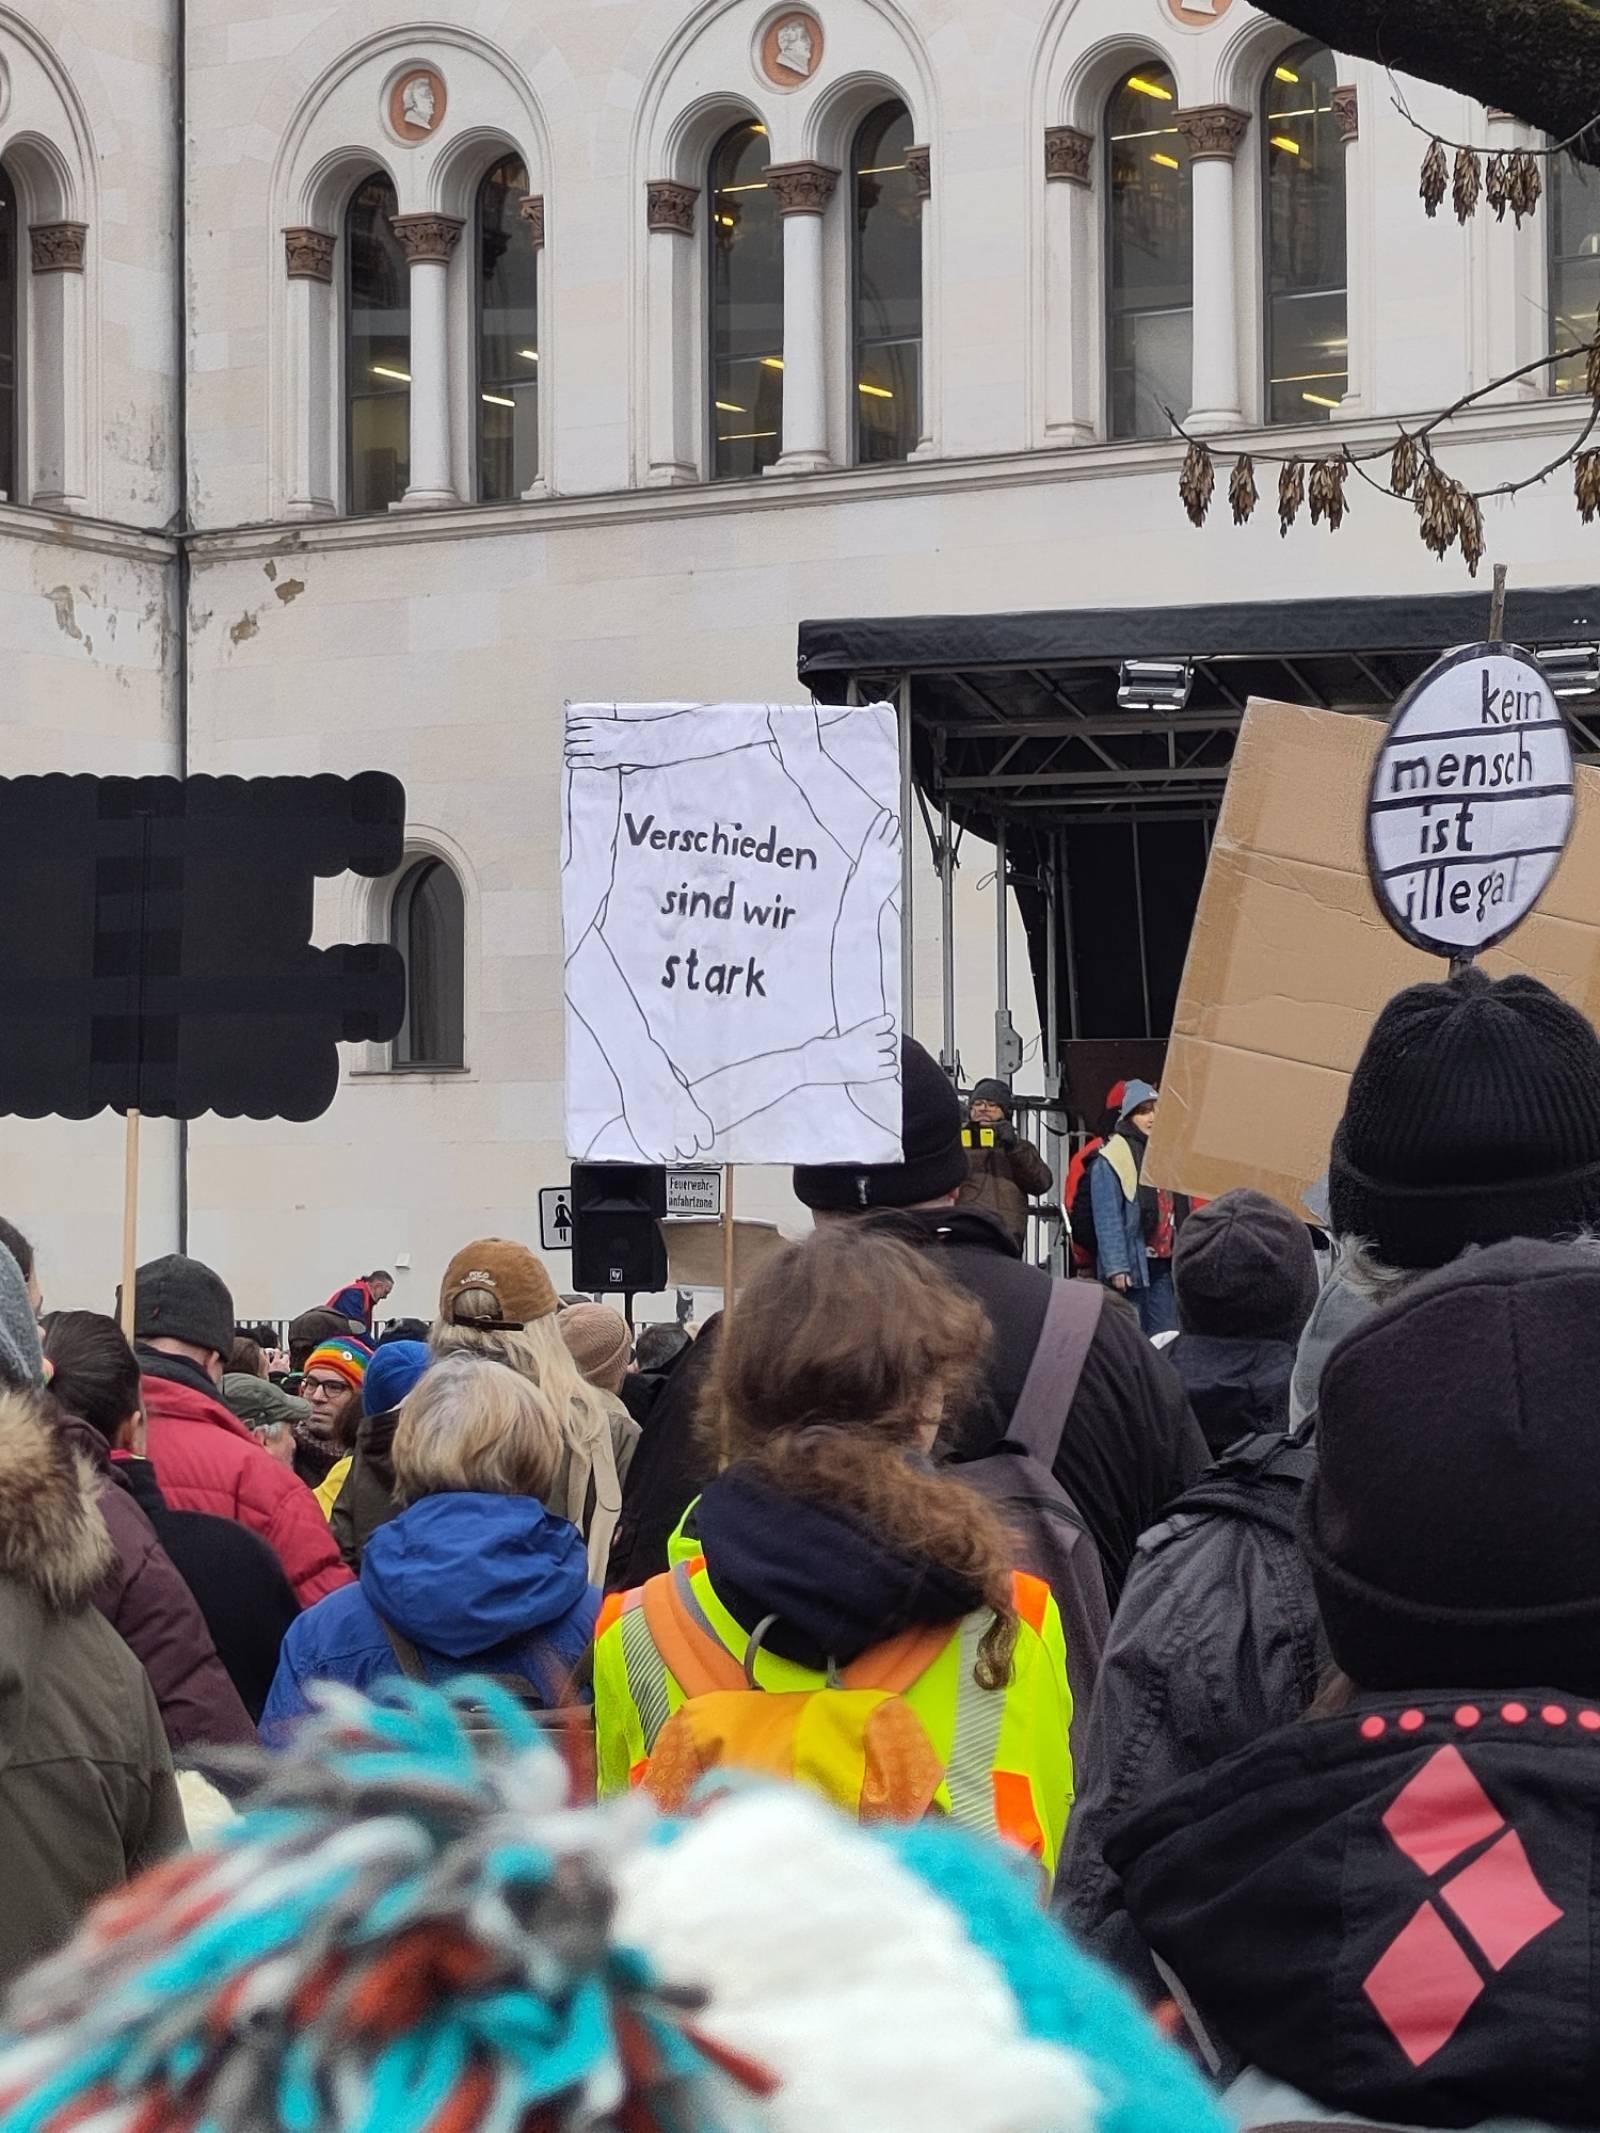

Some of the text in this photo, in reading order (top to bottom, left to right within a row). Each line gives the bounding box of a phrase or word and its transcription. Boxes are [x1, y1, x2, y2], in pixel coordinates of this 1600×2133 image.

[1481, 669, 1542, 724] kein
[1390, 731, 1533, 792] mensch
[624, 812, 818, 871] Verschieden
[1419, 801, 1474, 854] ist
[660, 881, 796, 930] sind wir
[1404, 857, 1520, 923] illegal
[661, 948, 767, 997] stark
